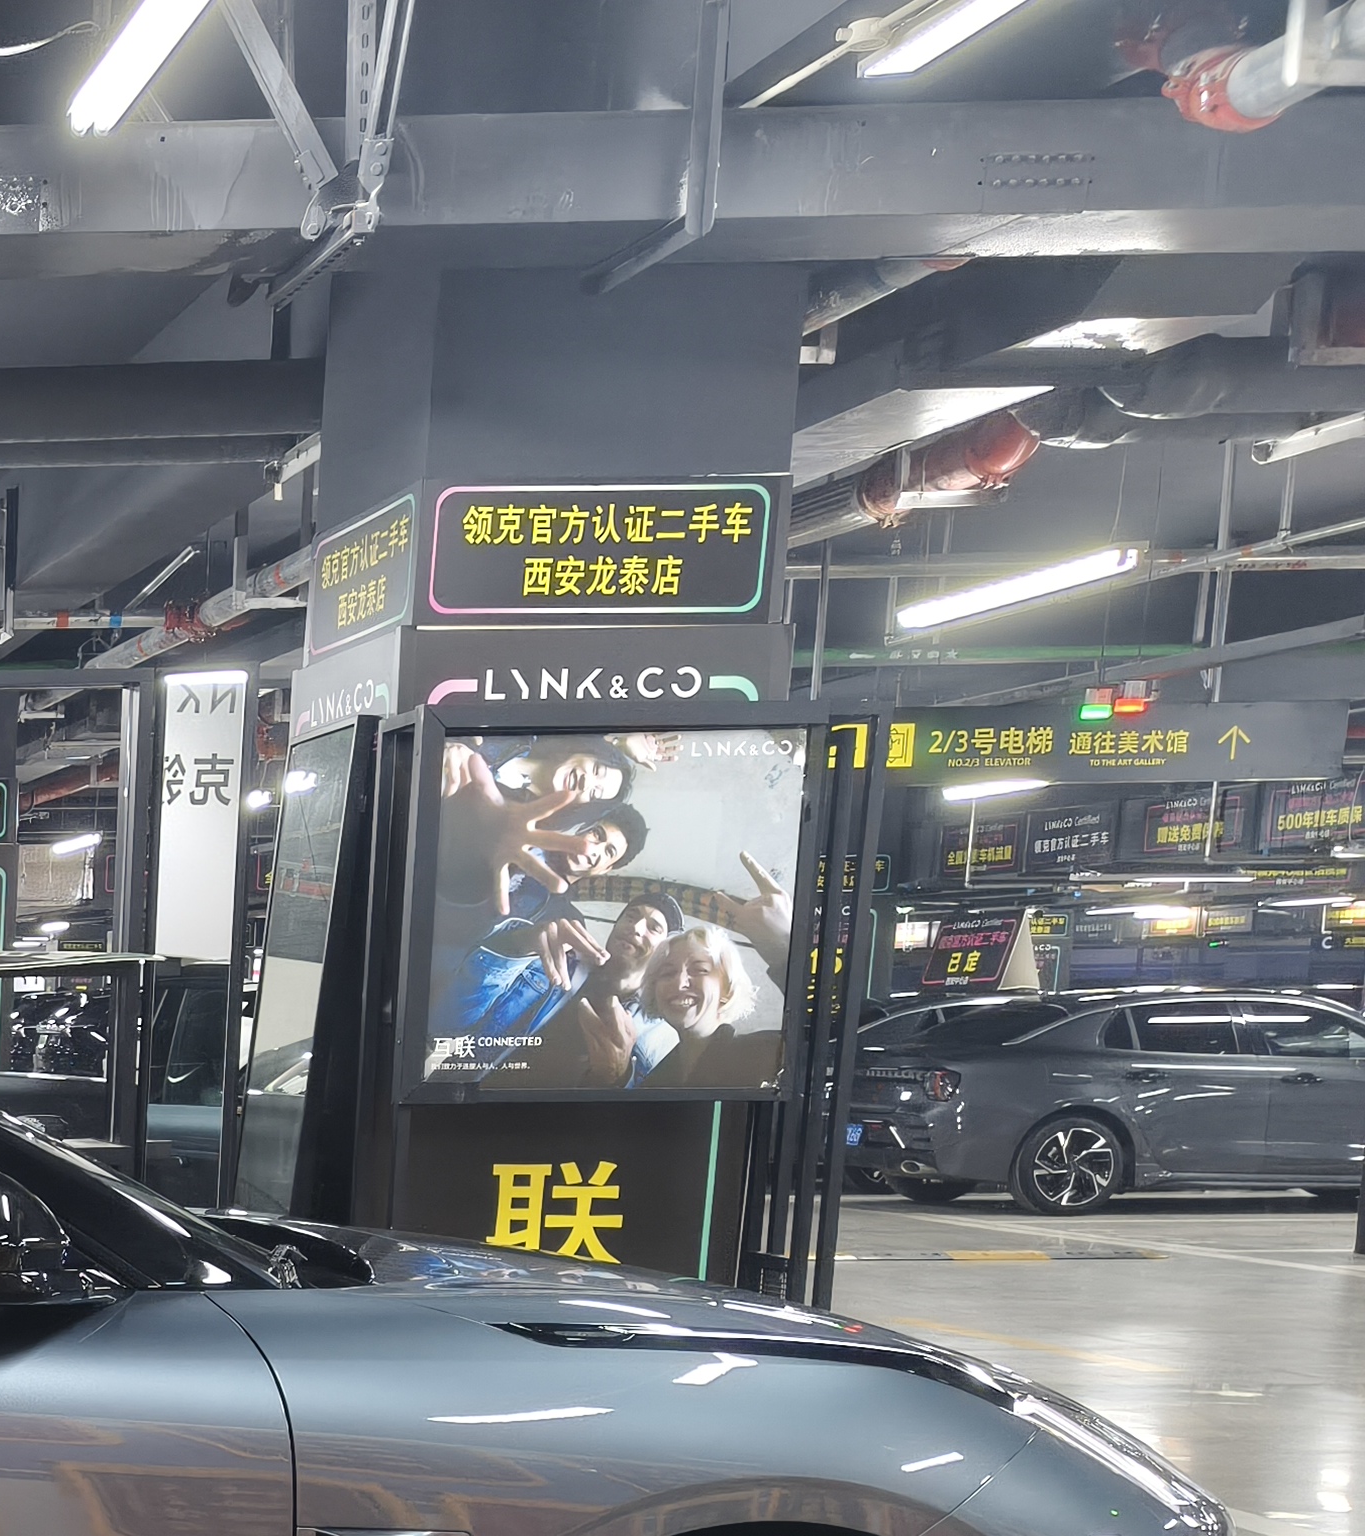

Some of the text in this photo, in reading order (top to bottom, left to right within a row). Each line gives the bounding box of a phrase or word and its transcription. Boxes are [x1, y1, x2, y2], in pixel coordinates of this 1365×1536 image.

[463, 502, 753, 546] 领克官方认证二手车
[321, 514, 410, 589] 领克官方认证二手车
[523, 555, 684, 596] 西安龙泰店
[337, 574, 387, 630] 西安龙泰店
[484, 666, 702, 700] LYNK&CO
[311, 679, 374, 727] LYNK&CO
[691, 740, 793, 757] LYNK&CO
[928, 726, 1190, 756] 2/3号电梯 通往美术馆
[985, 757, 1031, 766] ELEVATOR
[1134, 758, 1166, 766] GALLERY
[433, 1036, 542, 1058] 互联 CONNECTED
[486, 1161, 623, 1264] 联
